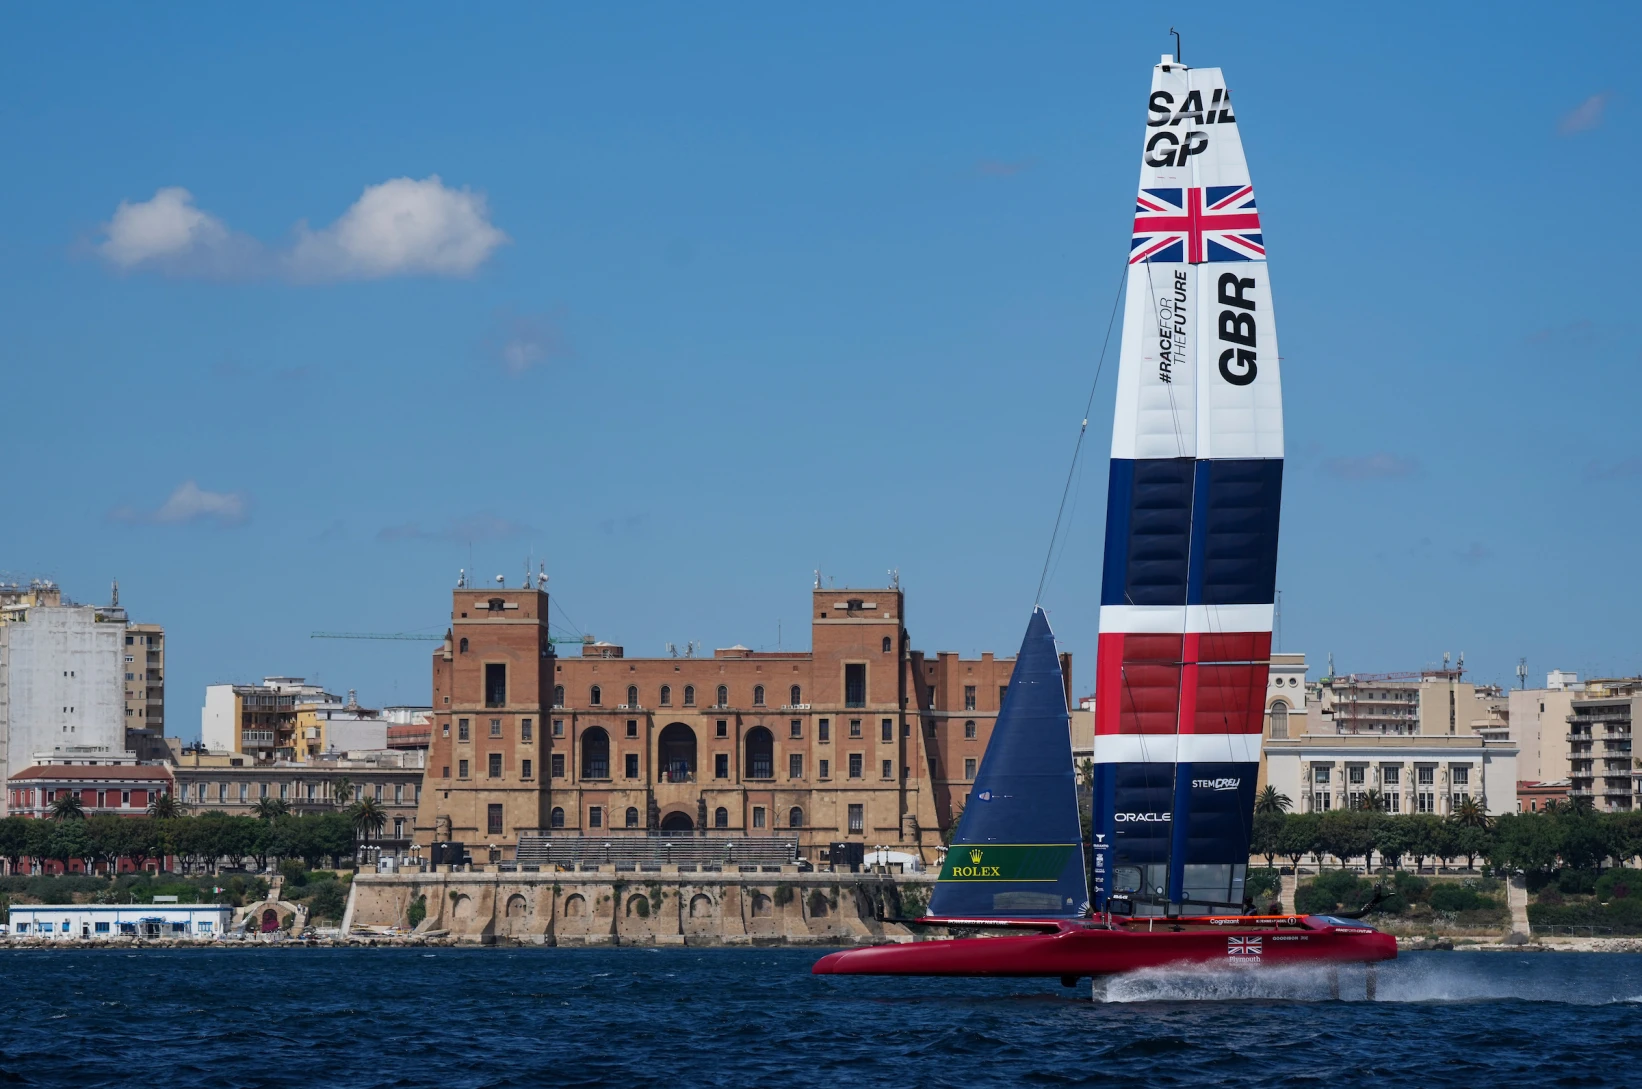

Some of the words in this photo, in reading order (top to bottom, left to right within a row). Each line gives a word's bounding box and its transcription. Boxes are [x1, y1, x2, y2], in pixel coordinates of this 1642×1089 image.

[1146, 88, 1236, 127] SAIL
[1144, 131, 1209, 168] GP
[1173, 269, 1188, 365] THEFUTURE
[1218, 272, 1258, 386] GBR
[1159, 297, 1173, 384] #RACEFOR
[1114, 812, 1171, 822] ORACLE
[952, 867, 1001, 877] ROLEX
[1209, 918, 1240, 926] Cognizant
[1229, 955, 1261, 963] Plymouth
